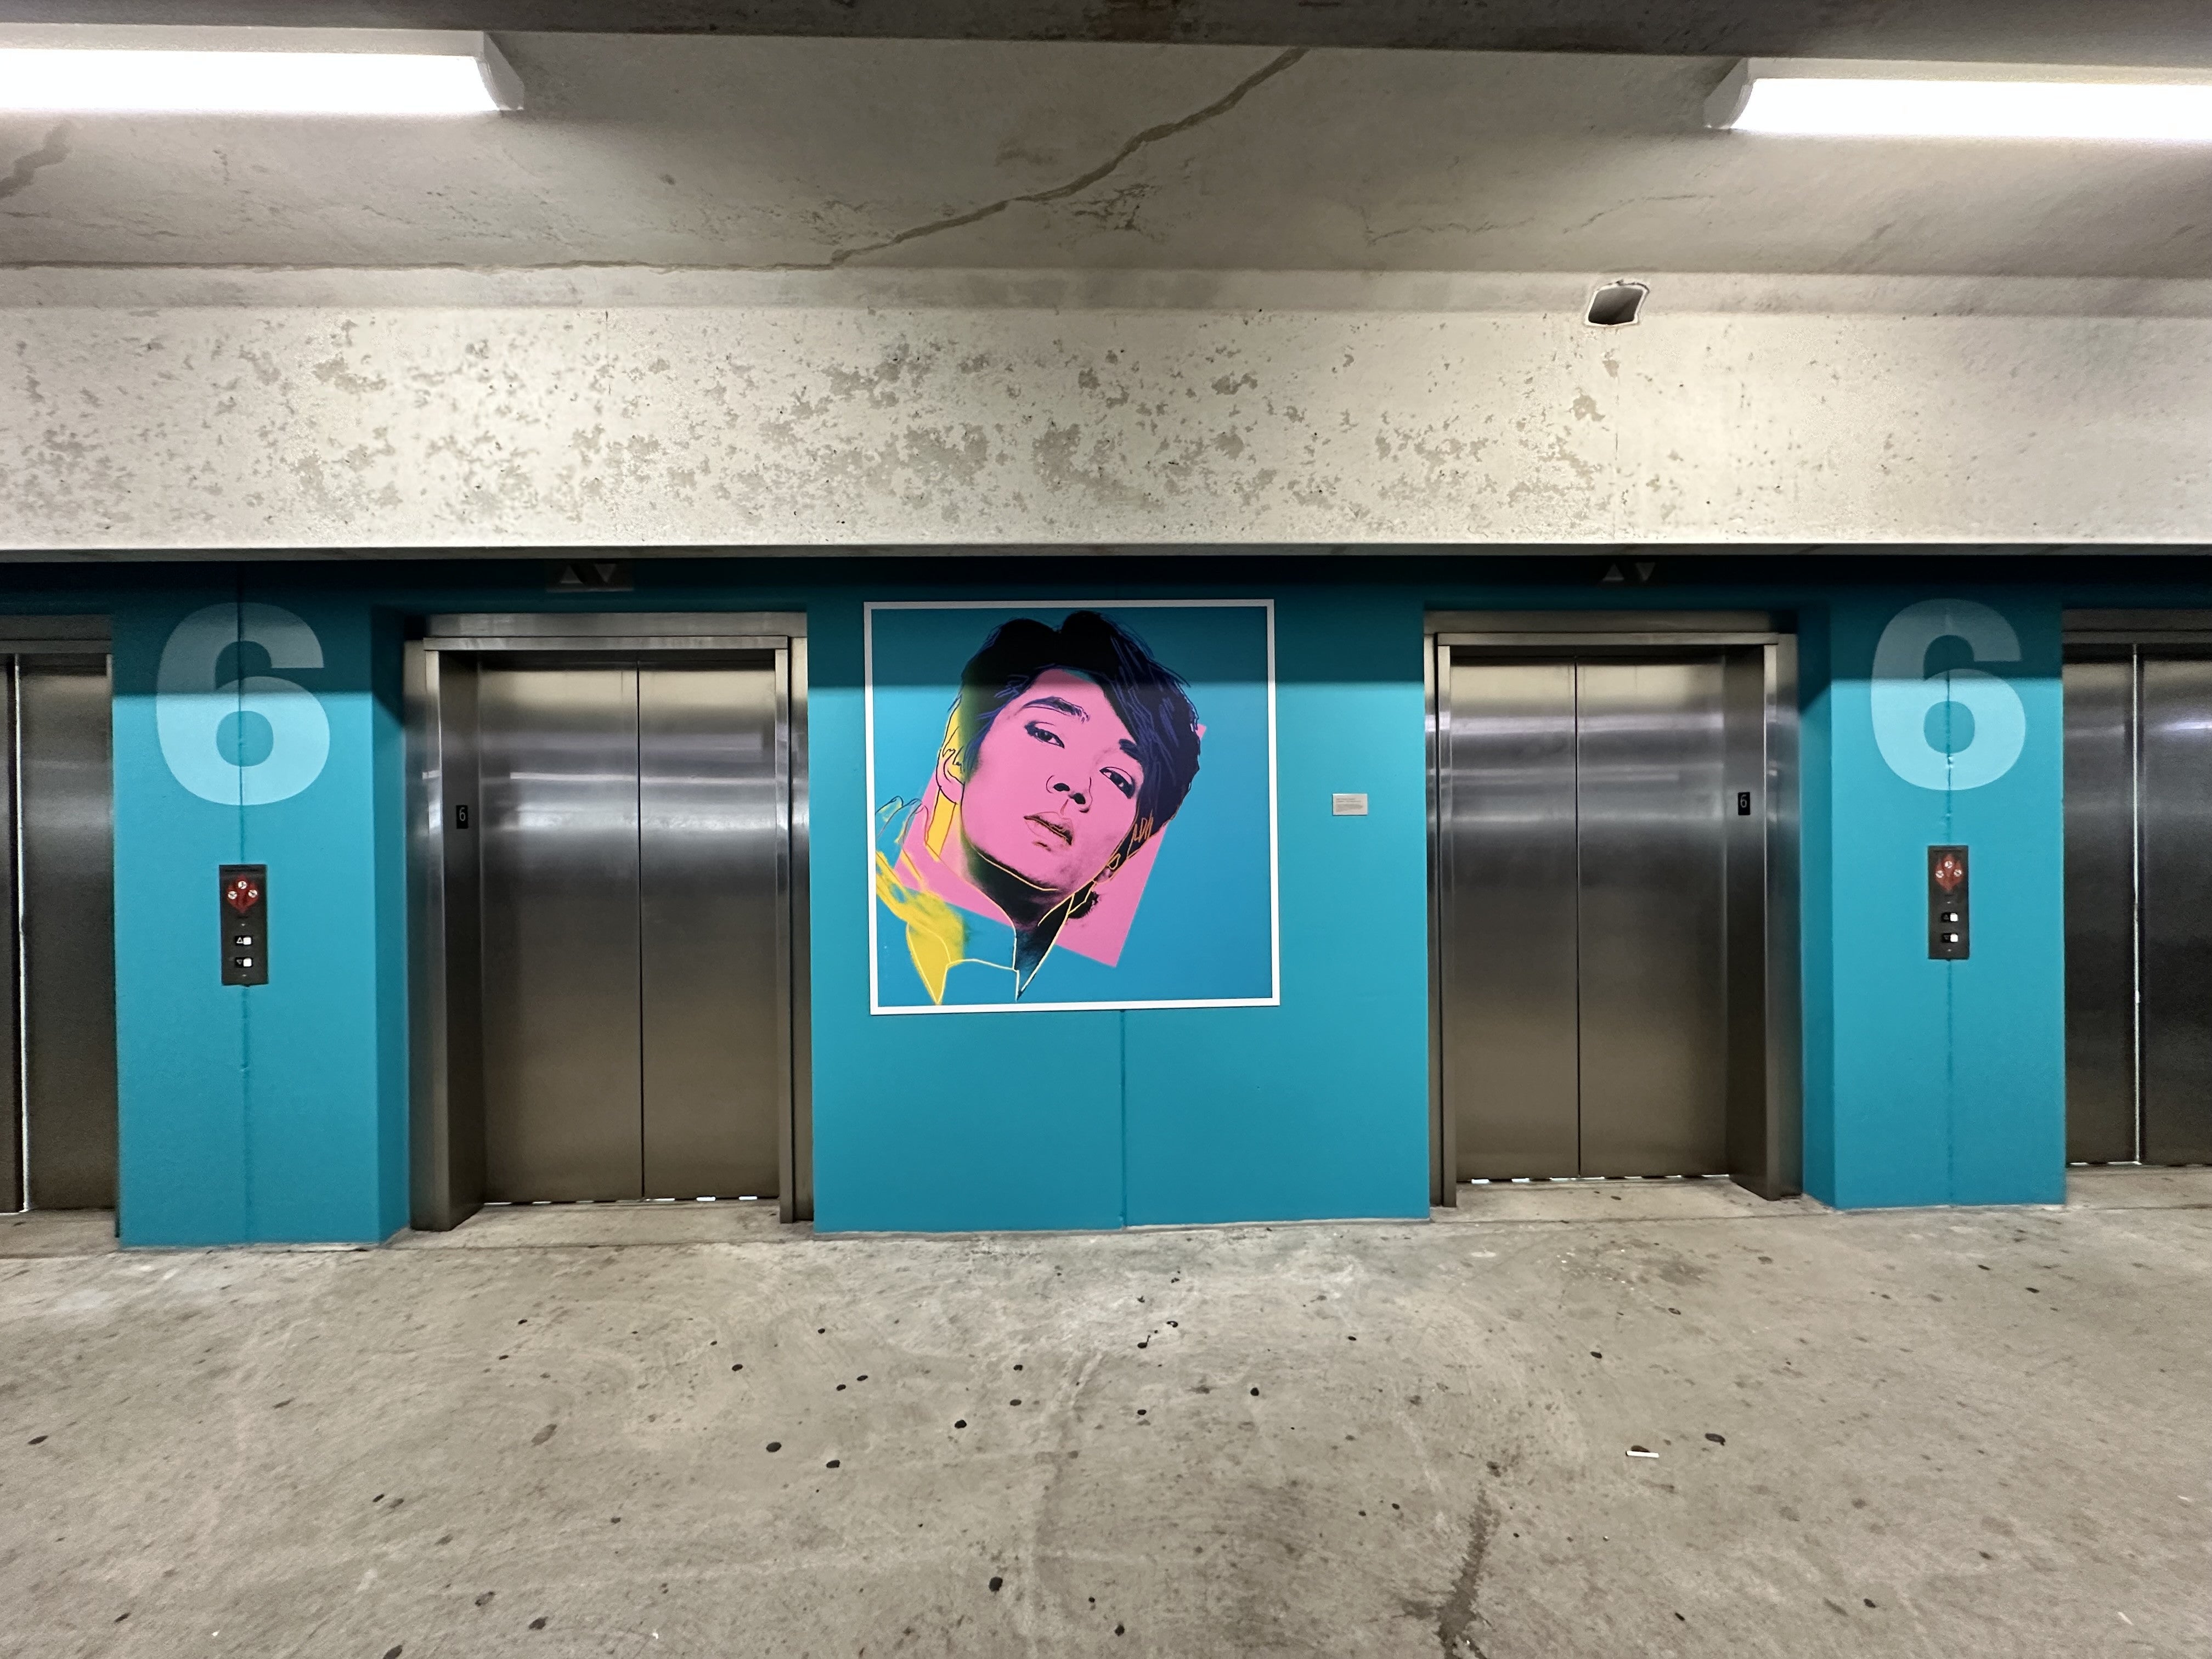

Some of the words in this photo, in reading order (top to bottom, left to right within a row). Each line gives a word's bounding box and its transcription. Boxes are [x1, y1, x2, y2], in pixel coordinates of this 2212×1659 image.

[156, 602, 330, 806] 6
[1871, 599, 2026, 791] 6
[459, 807, 466, 821] 6
[1740, 794, 1747, 808] 6
